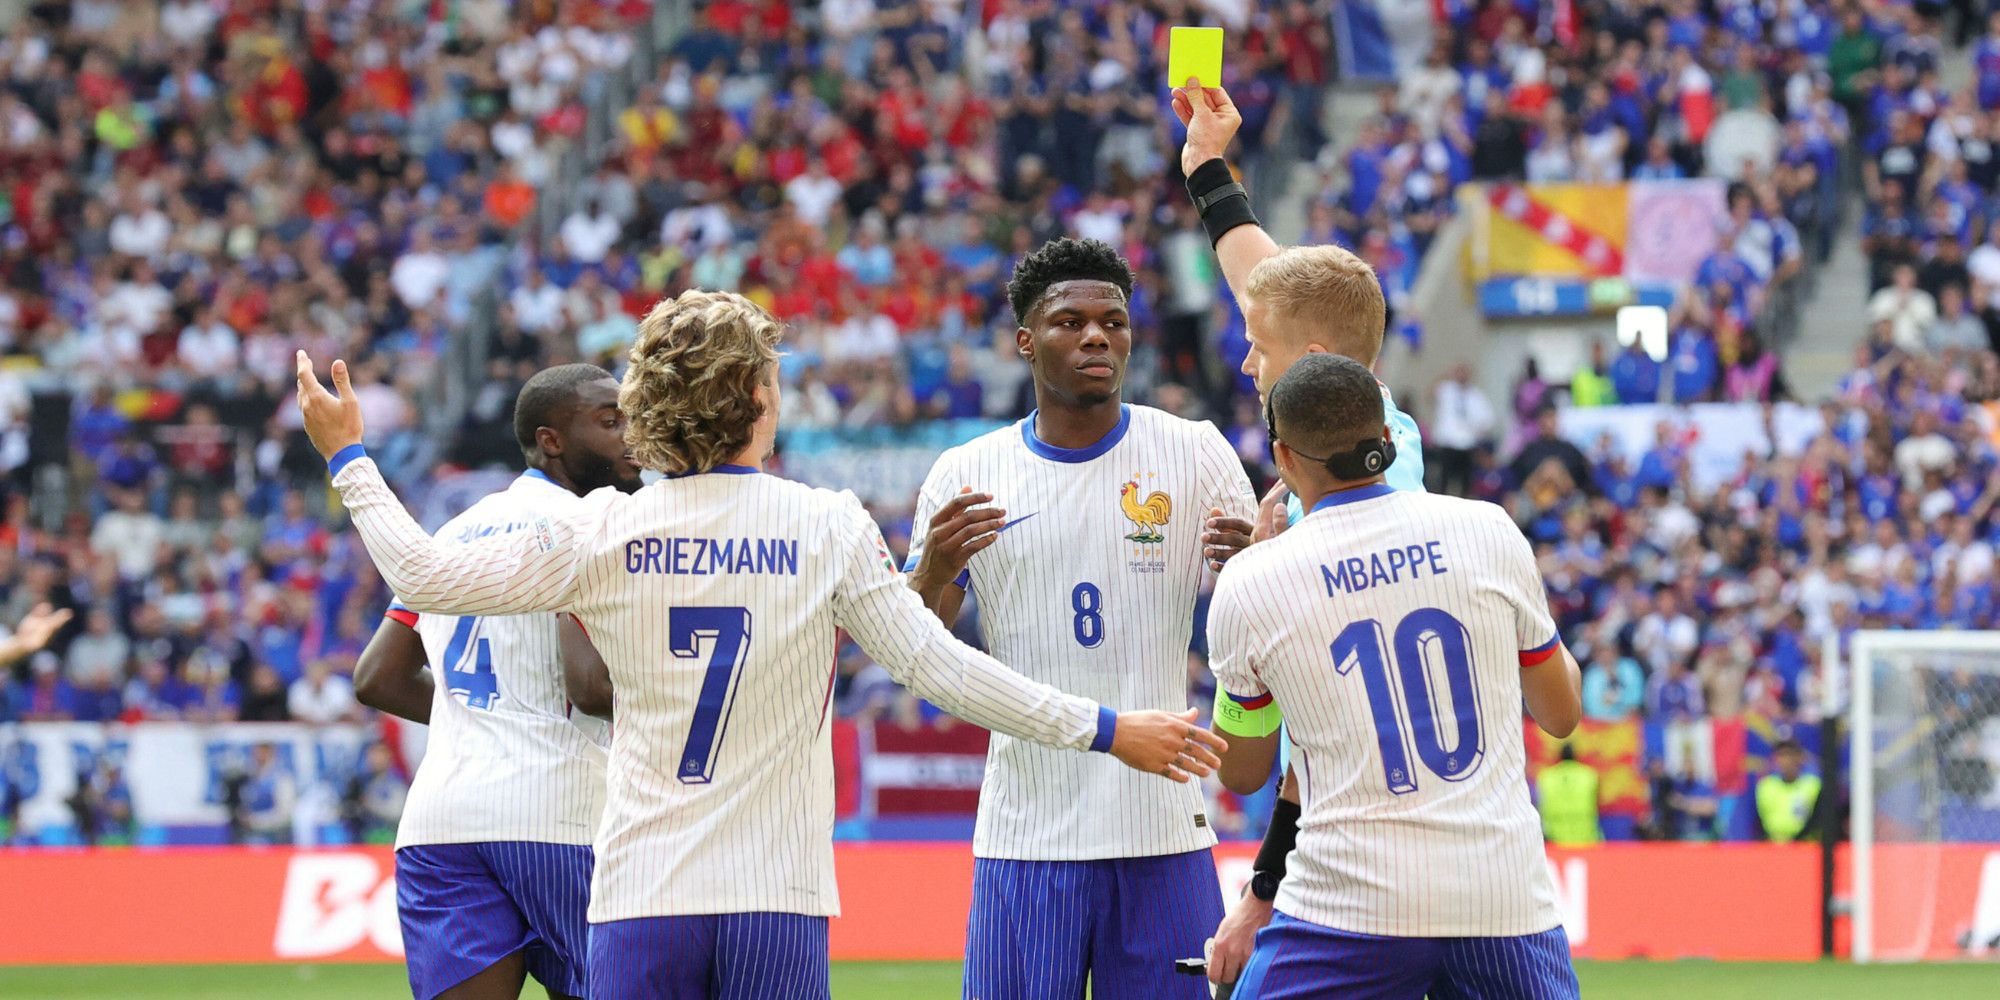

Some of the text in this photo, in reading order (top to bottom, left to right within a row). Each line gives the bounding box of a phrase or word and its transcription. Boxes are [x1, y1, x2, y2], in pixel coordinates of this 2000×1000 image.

[625, 538, 797, 575] GRIEZMANN
[1320, 540, 1448, 598] MBAPPE
[1072, 582, 1105, 649] 8
[444, 616, 500, 712] 4
[669, 606, 751, 784] 7
[1330, 607, 1486, 795] 10
